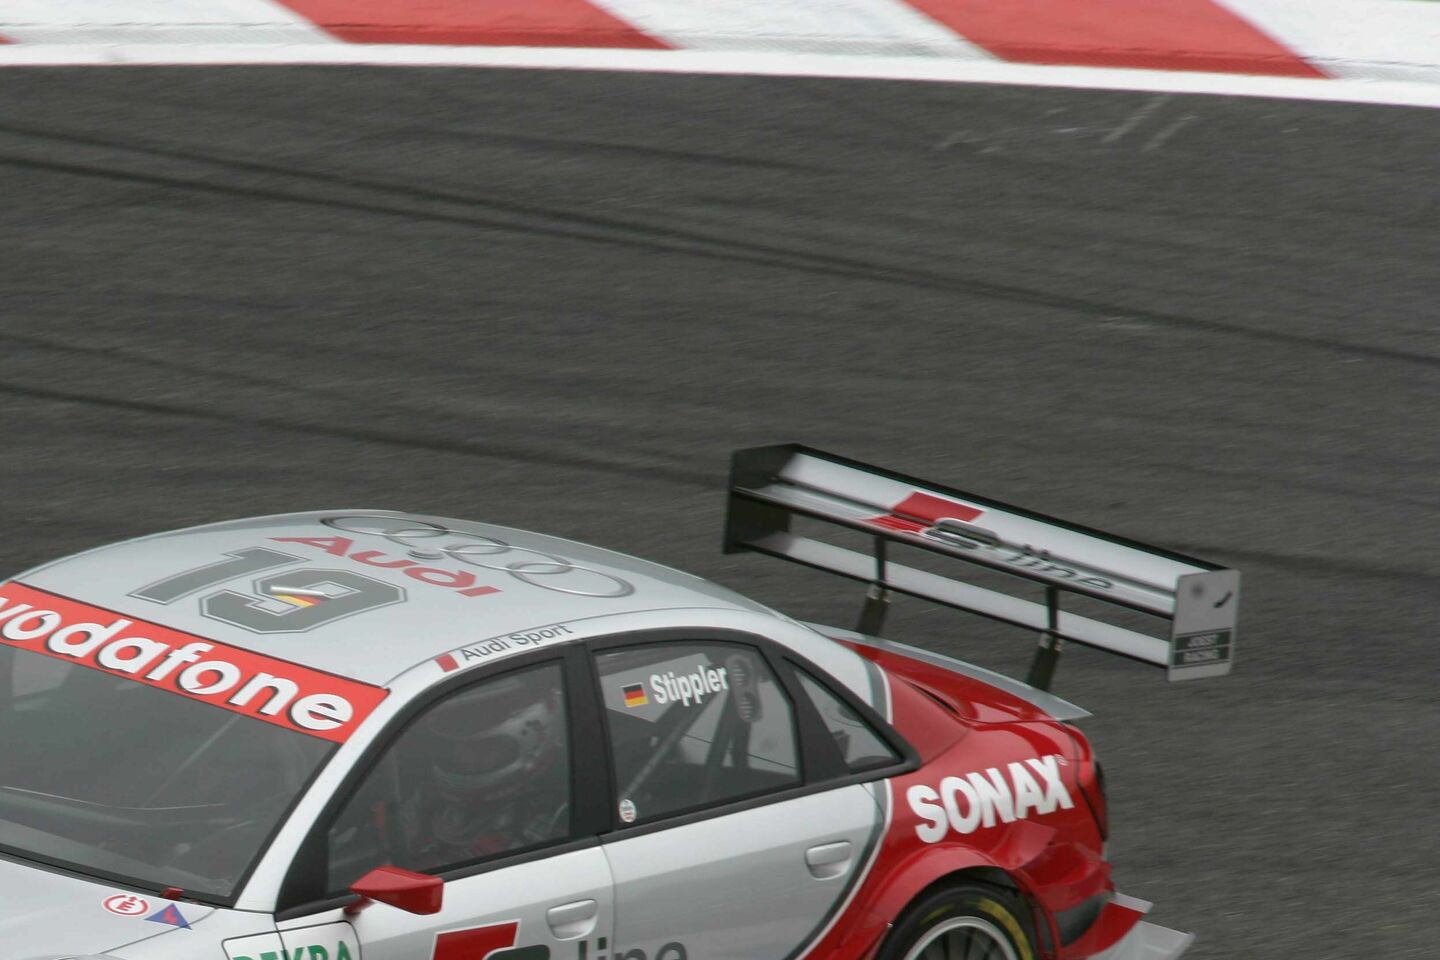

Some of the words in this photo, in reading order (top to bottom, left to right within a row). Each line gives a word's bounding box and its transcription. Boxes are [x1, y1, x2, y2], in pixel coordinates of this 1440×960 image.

[460, 637, 512, 661] Audi
[509, 623, 574, 646] Sport
[649, 665, 728, 707] Stippler
[906, 755, 1075, 843] SONAX
